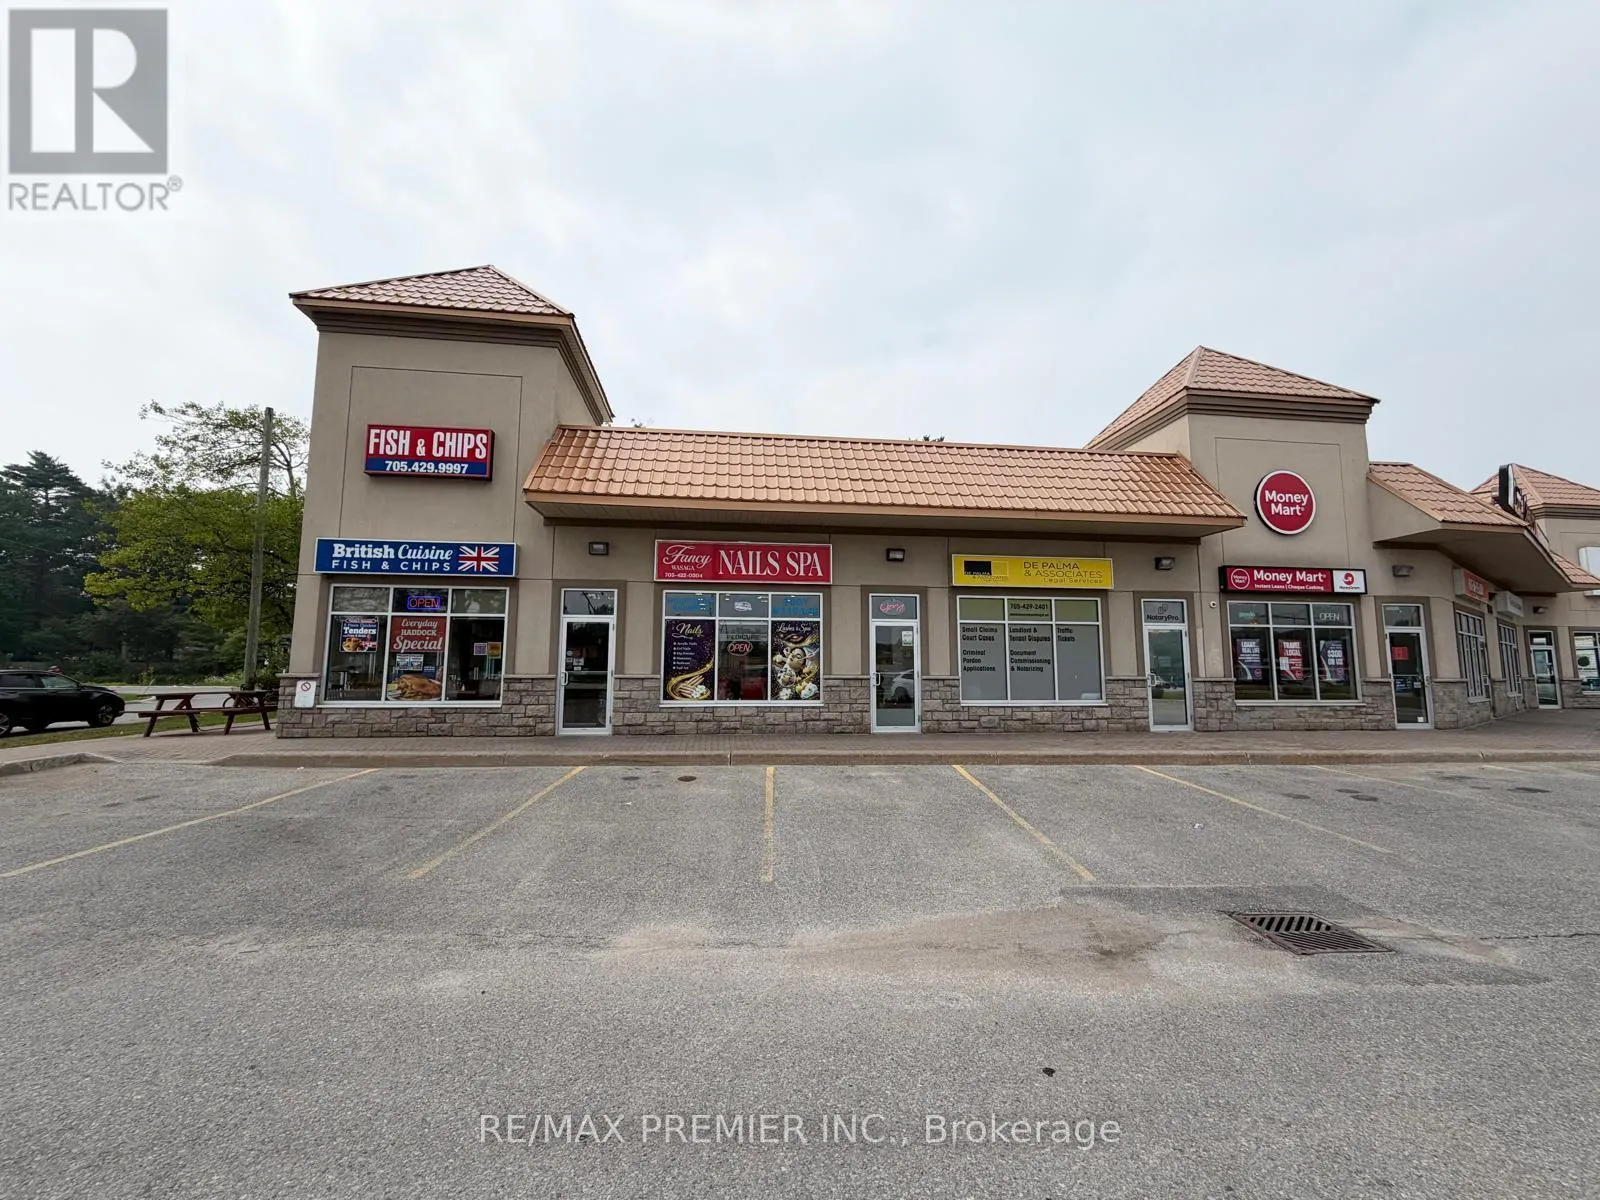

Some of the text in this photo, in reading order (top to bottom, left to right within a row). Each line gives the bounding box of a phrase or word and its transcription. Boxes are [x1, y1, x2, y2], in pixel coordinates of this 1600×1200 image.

[368, 428, 488, 460] FISH & CHIPS
[385, 460, 469, 474] 705.429.9997
[1264, 489, 1309, 506] Money
[1270, 503, 1302, 516] Mart
[332, 543, 454, 560] British Cuisine
[662, 544, 713, 569] Fancy
[331, 559, 451, 572] FISH & CHIPS
[718, 549, 824, 577] NAILS SPA
[1023, 561, 1080, 570] DE PALMA
[1023, 569, 1103, 579] & ASSOCIATES
[1253, 569, 1324, 584] Money Mart
[410, 598, 439, 608] OPEN
[1319, 612, 1340, 621] OPEN
[343, 626, 377, 635] Tenders
[401, 618, 438, 630] Everyday
[675, 622, 704, 635] Nails
[393, 635, 444, 653] Special
[729, 643, 751, 653] OPEN
[1016, 665, 1044, 673] Notarizing
